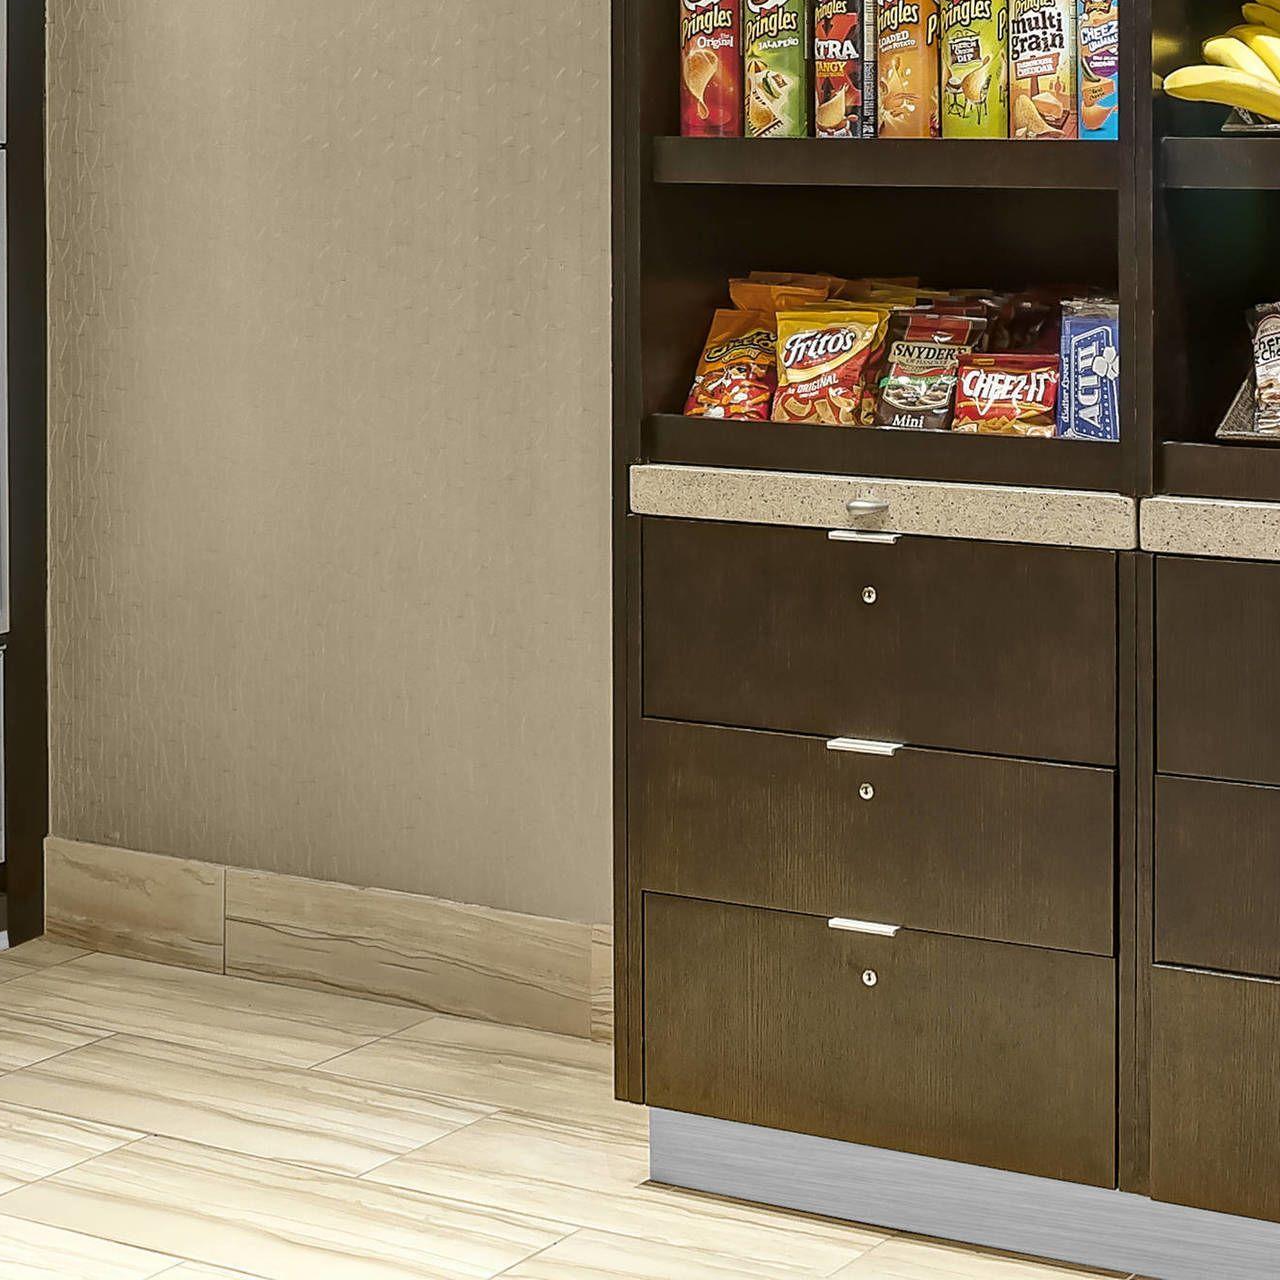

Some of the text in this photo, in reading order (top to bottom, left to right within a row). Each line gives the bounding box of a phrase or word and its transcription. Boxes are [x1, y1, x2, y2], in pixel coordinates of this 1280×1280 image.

[682, 9, 733, 49] Pringles
[746, 10, 797, 53] Pringles
[1012, 11, 1063, 34] multi
[696, 35, 734, 50] Original
[1011, 31, 1065, 61] grain
[894, 344, 967, 361] SNYDER'S
[797, 374, 838, 393] ORIGINAL
[963, 370, 1048, 404] CHEEZ-IT
[1078, 374, 1103, 429] ACT
[892, 414, 925, 429] Mini
